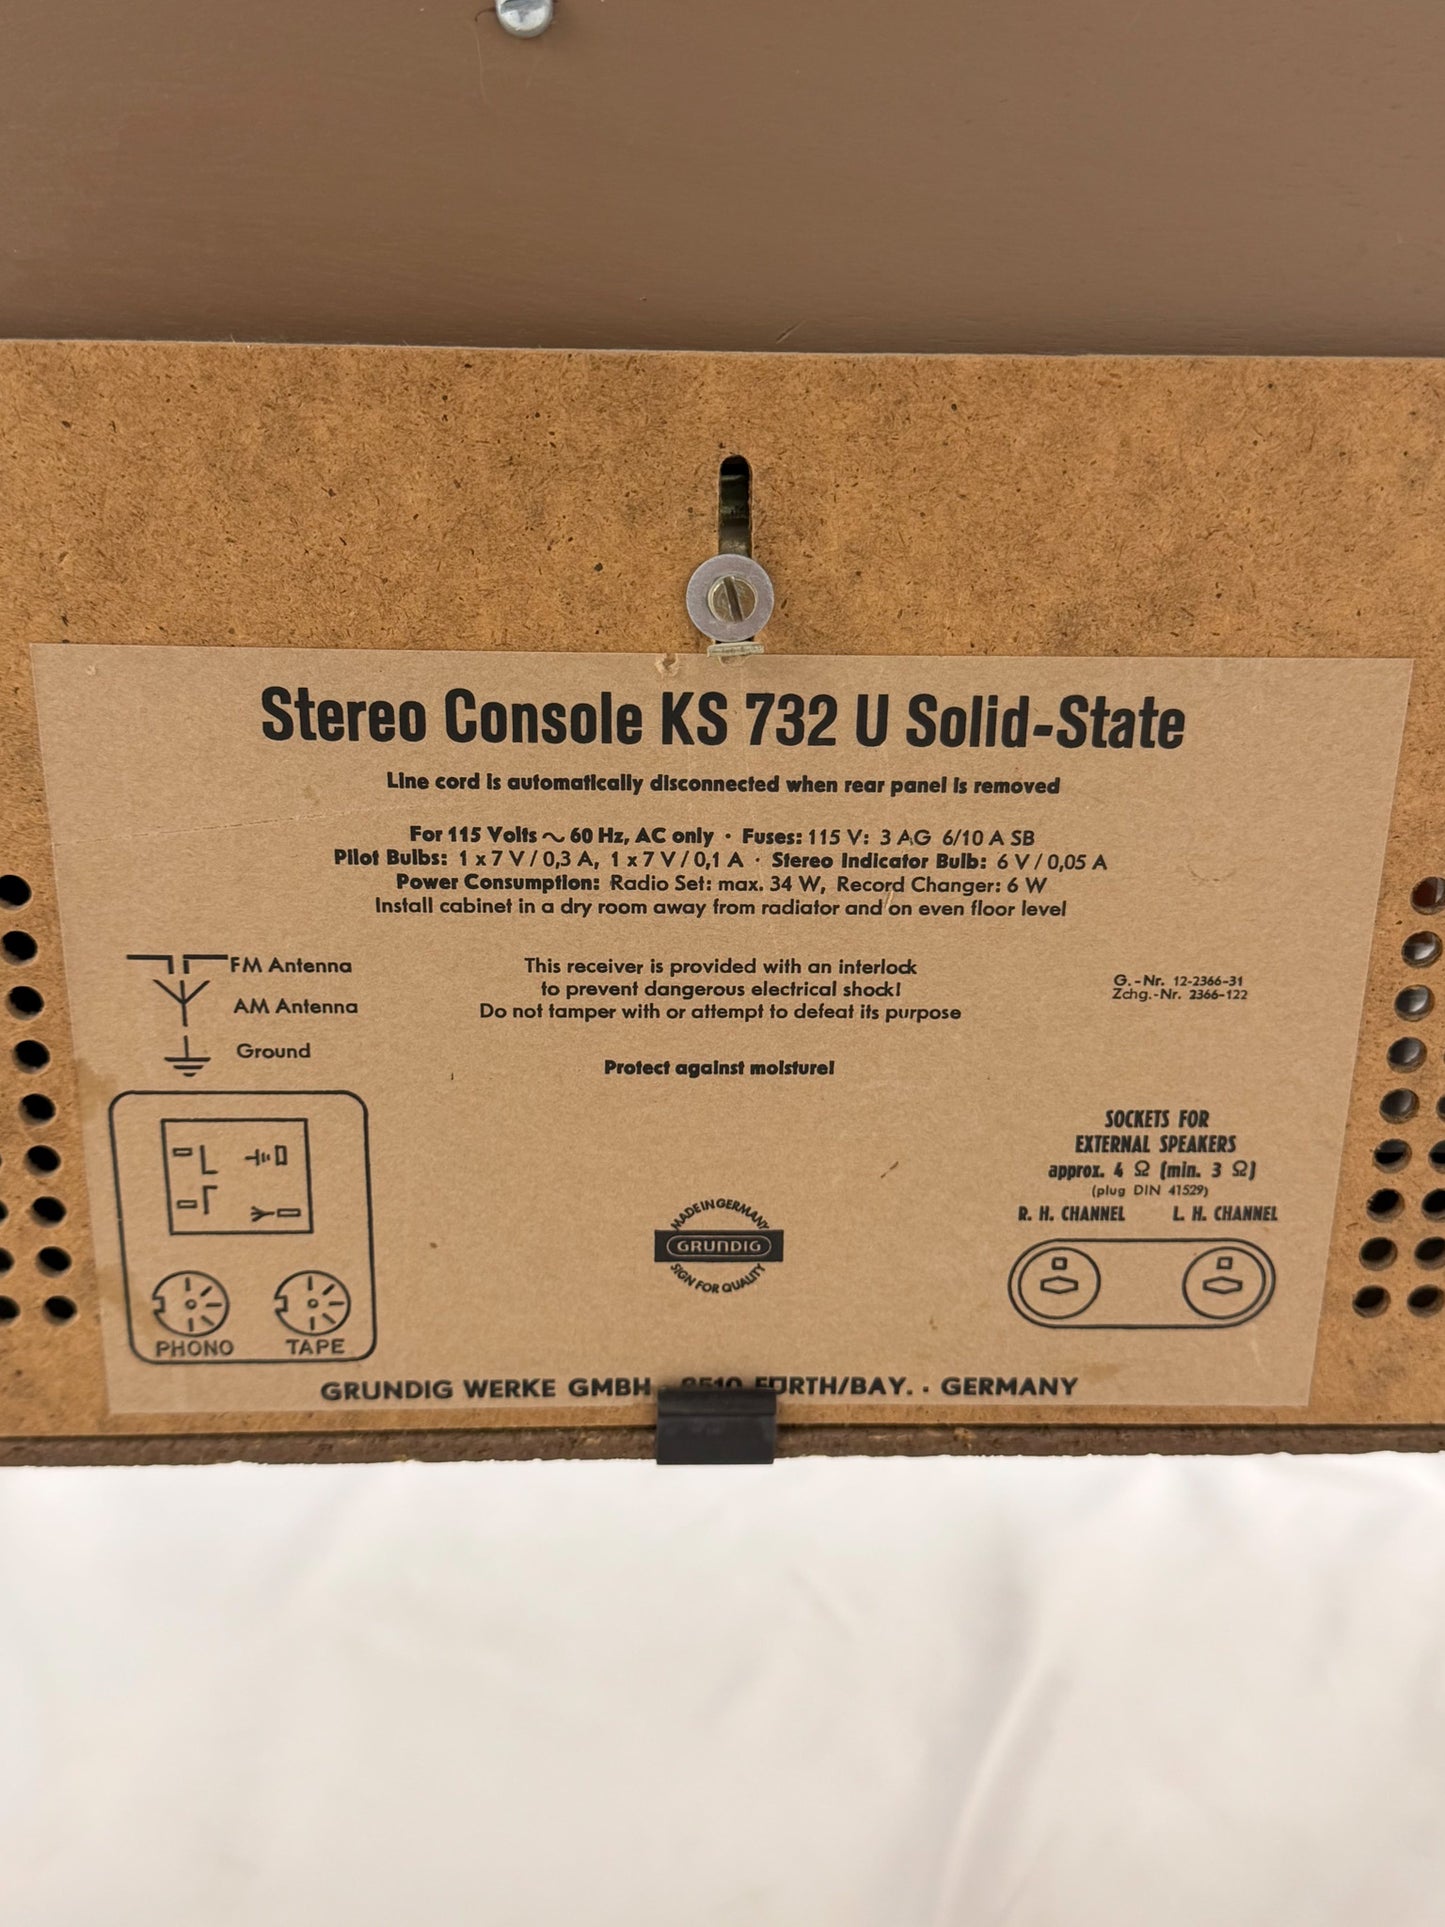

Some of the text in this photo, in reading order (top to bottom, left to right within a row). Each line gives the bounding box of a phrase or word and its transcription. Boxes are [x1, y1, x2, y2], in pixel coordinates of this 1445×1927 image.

[261, 686, 1185, 749] Stereo Console KS 732 U Solid-State
[387, 771, 1060, 797] Line cord is automatically disconnected when rear panel is removed
[410, 826, 1035, 848] For 115 Volts 60 Hz, AC only Fuses: 115 V: 3 AG 6/10 A SB
[334, 848, 379, 866] Pilot
[387, 849, 447, 865] Bulbs:
[460, 850, 466, 866] 1
[476, 855, 486, 866] x
[491, 850, 503, 866] 7
[509, 850, 525, 866] V
[543, 850, 571, 869] 0,3
[577, 851, 599, 870] A,
[612, 851, 618, 867] 1
[627, 856, 637, 867] x
[643, 851, 654, 867] 7
[660, 851, 676, 867] V
[694, 851, 719, 870] 0,1
[727, 851, 744, 868] A
[772, 852, 833, 868] Stereo
[842, 852, 929, 869] Indicator
[936, 853, 986, 869] Bulb:
[997, 852, 1008, 869] 6
[1015, 854, 1030, 870] V
[1048, 854, 1086, 872] 0,05
[1092, 854, 1107, 870] A
[397, 873, 1047, 898] Power Consumption: Radio Set: max. 34 W, Record Changer: 6 W
[376, 897, 1067, 918] Install cabinet in a dry room away from radiator and on even floor level
[231, 957, 352, 973] FM Antenna
[524, 957, 917, 977] This receiver is provided with an interlock
[541, 980, 901, 1000] to prevent dangerous electrical shock!
[1174, 976, 1242, 986] 12-2366-31
[1189, 989, 1248, 1000] 2366-122
[233, 998, 358, 1014] AM Antenna
[480, 1003, 961, 1023] Do not tamper with or attempt to defeat its purpose
[237, 1043, 311, 1059] Ground
[605, 1060, 835, 1078] Protect against moisture!
[1105, 1110, 1209, 1128] SOCKETS FOR
[1075, 1135, 1236, 1153] EXTERNAL SPEAKERS
[1048, 1165, 1105, 1181] approx.
[1114, 1162, 1123, 1178] 4
[1211, 1162, 1222, 1178] 3
[1092, 1184, 1208, 1198] (plug DIN 41529)
[671, 1198, 770, 1231] MADE IN GERMANY
[1018, 1206, 1125, 1222] R. H. CHANNEL
[1173, 1205, 1278, 1221] L. H. CHANNEL
[678, 1240, 761, 1252] GRUNDIG
[671, 1263, 766, 1293] SIGN FOR QUALITY
[156, 1340, 234, 1357] PHONO
[285, 1338, 345, 1355] TAPE
[321, 1380, 453, 1401] GRUNDIG
[463, 1378, 555, 1398] WERKE
[568, 1377, 651, 1397] GMBH
[941, 1377, 1078, 1396] GERMANY
